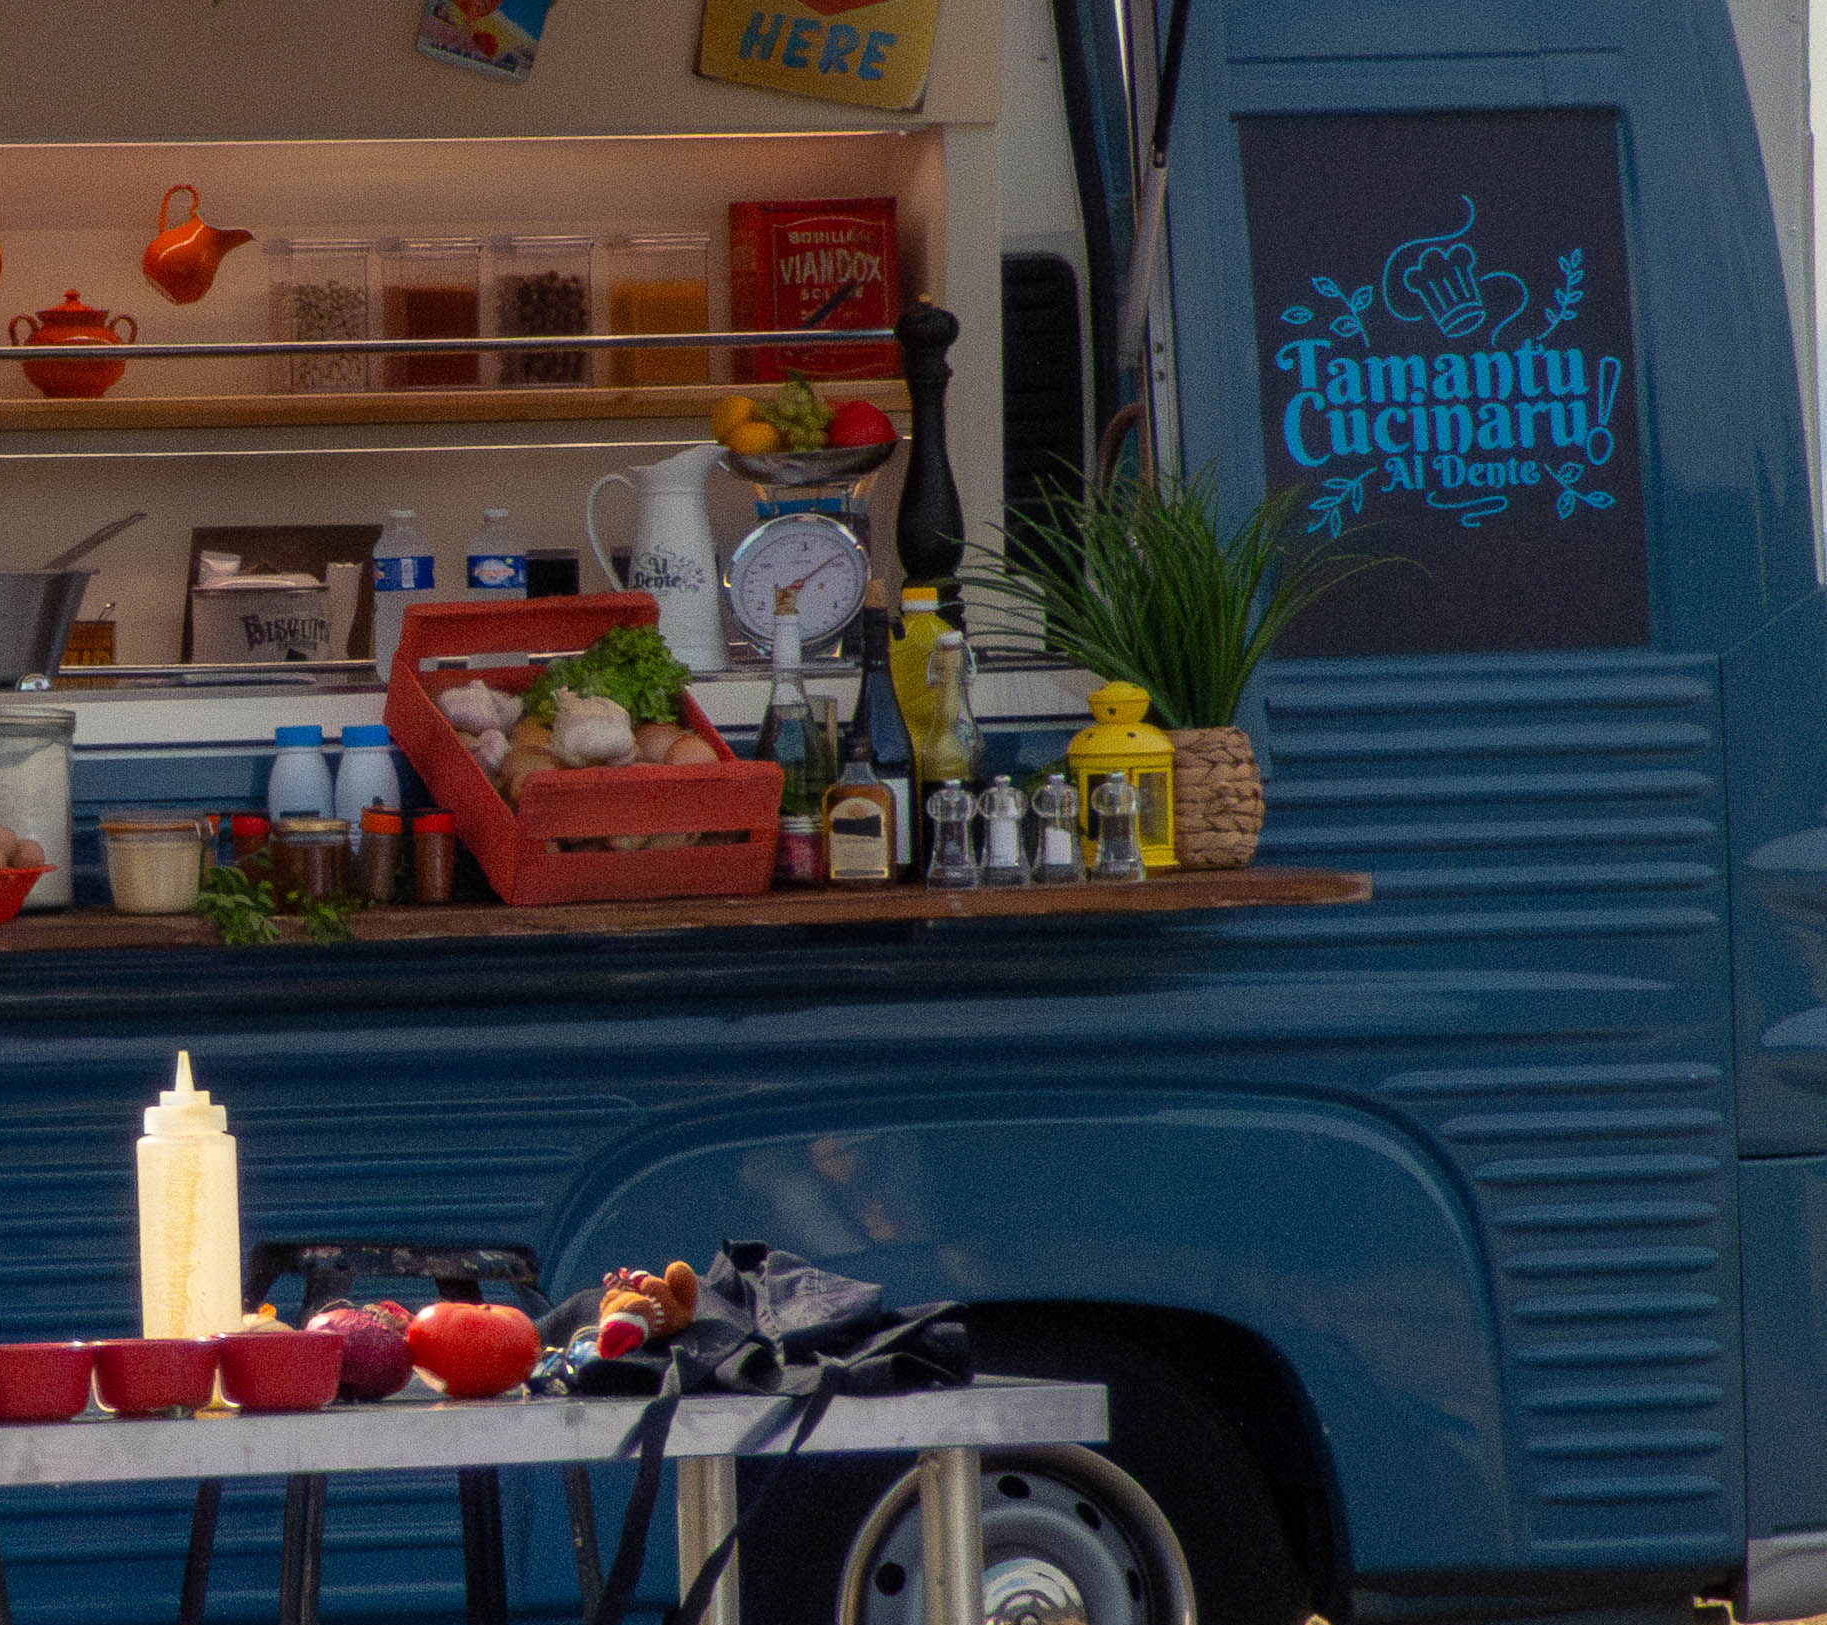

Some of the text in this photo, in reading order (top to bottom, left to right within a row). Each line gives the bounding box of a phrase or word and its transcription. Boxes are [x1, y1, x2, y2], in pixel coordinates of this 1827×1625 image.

[738, 11, 899, 82] HERE
[779, 247, 884, 286] VIANDOX
[1275, 337, 1590, 406] Tamantu
[1380, 454, 1541, 493] Al Dente
